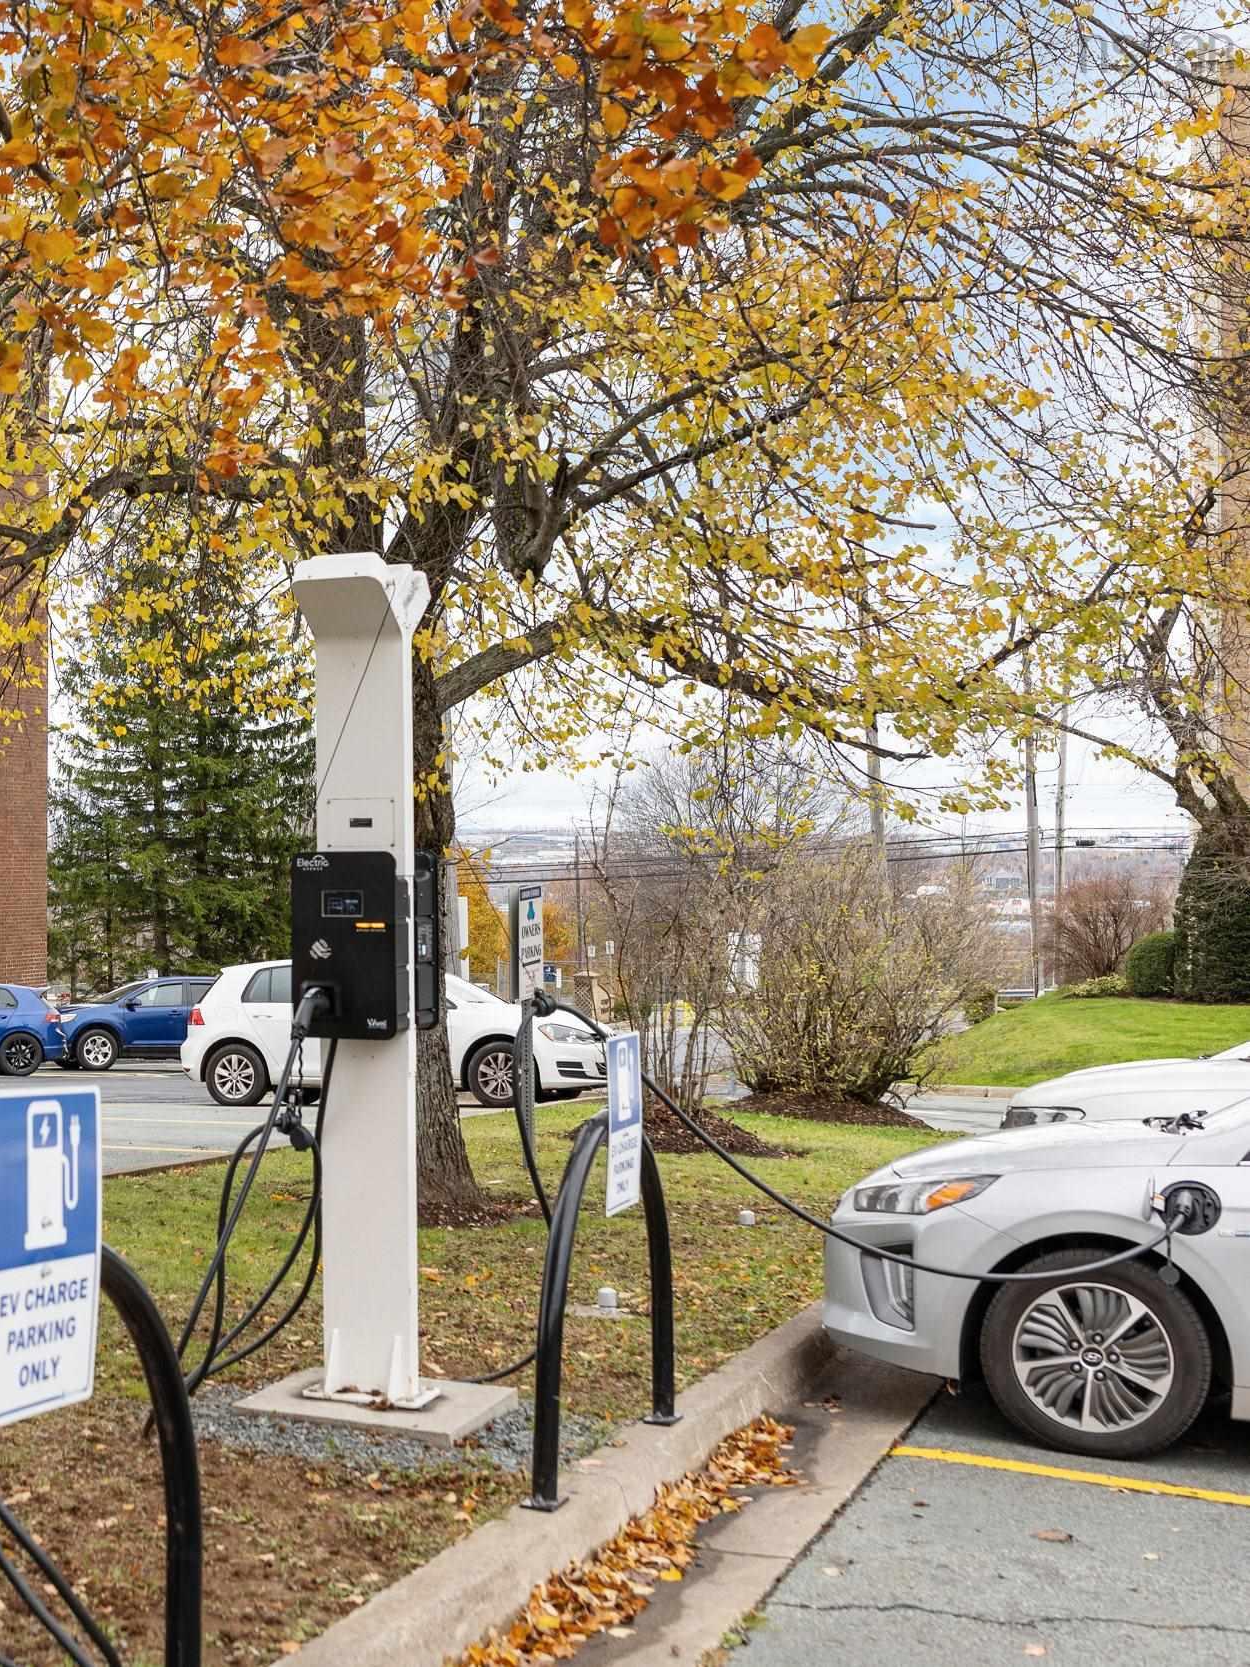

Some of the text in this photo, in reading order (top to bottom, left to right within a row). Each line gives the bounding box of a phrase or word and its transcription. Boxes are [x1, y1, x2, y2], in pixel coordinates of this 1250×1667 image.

[0, 1277, 88, 1318] EV CHARGE
[7, 1315, 76, 1354] PARKING
[18, 1355, 61, 1388] ONLY
